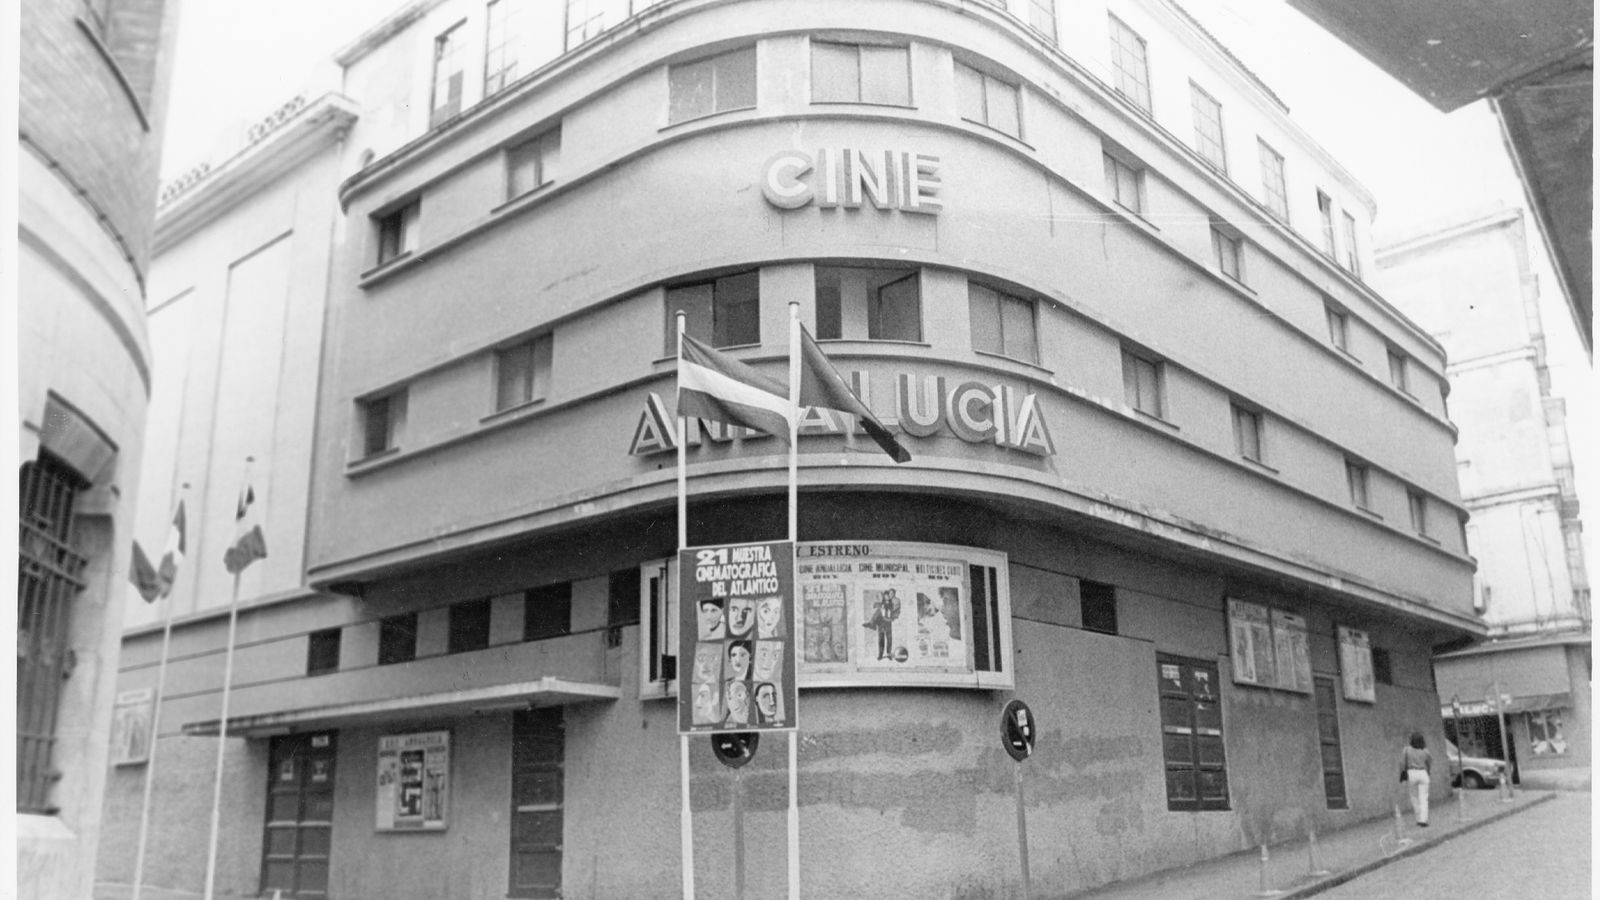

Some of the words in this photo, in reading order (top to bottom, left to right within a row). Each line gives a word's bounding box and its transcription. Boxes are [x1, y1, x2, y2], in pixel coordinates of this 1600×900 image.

[761, 148, 943, 213] CINE
[628, 370, 1057, 456] AALUCIA
[696, 548, 728, 566] 21
[732, 545, 772, 563] MUESTRA
[810, 544, 870, 557] ESTRENO
[696, 561, 777, 582] CINEMATOGRAFICA
[875, 562, 910, 573] MUNICIPAL
[712, 581, 727, 597] DEL
[730, 577, 779, 596] ATLANTICO
